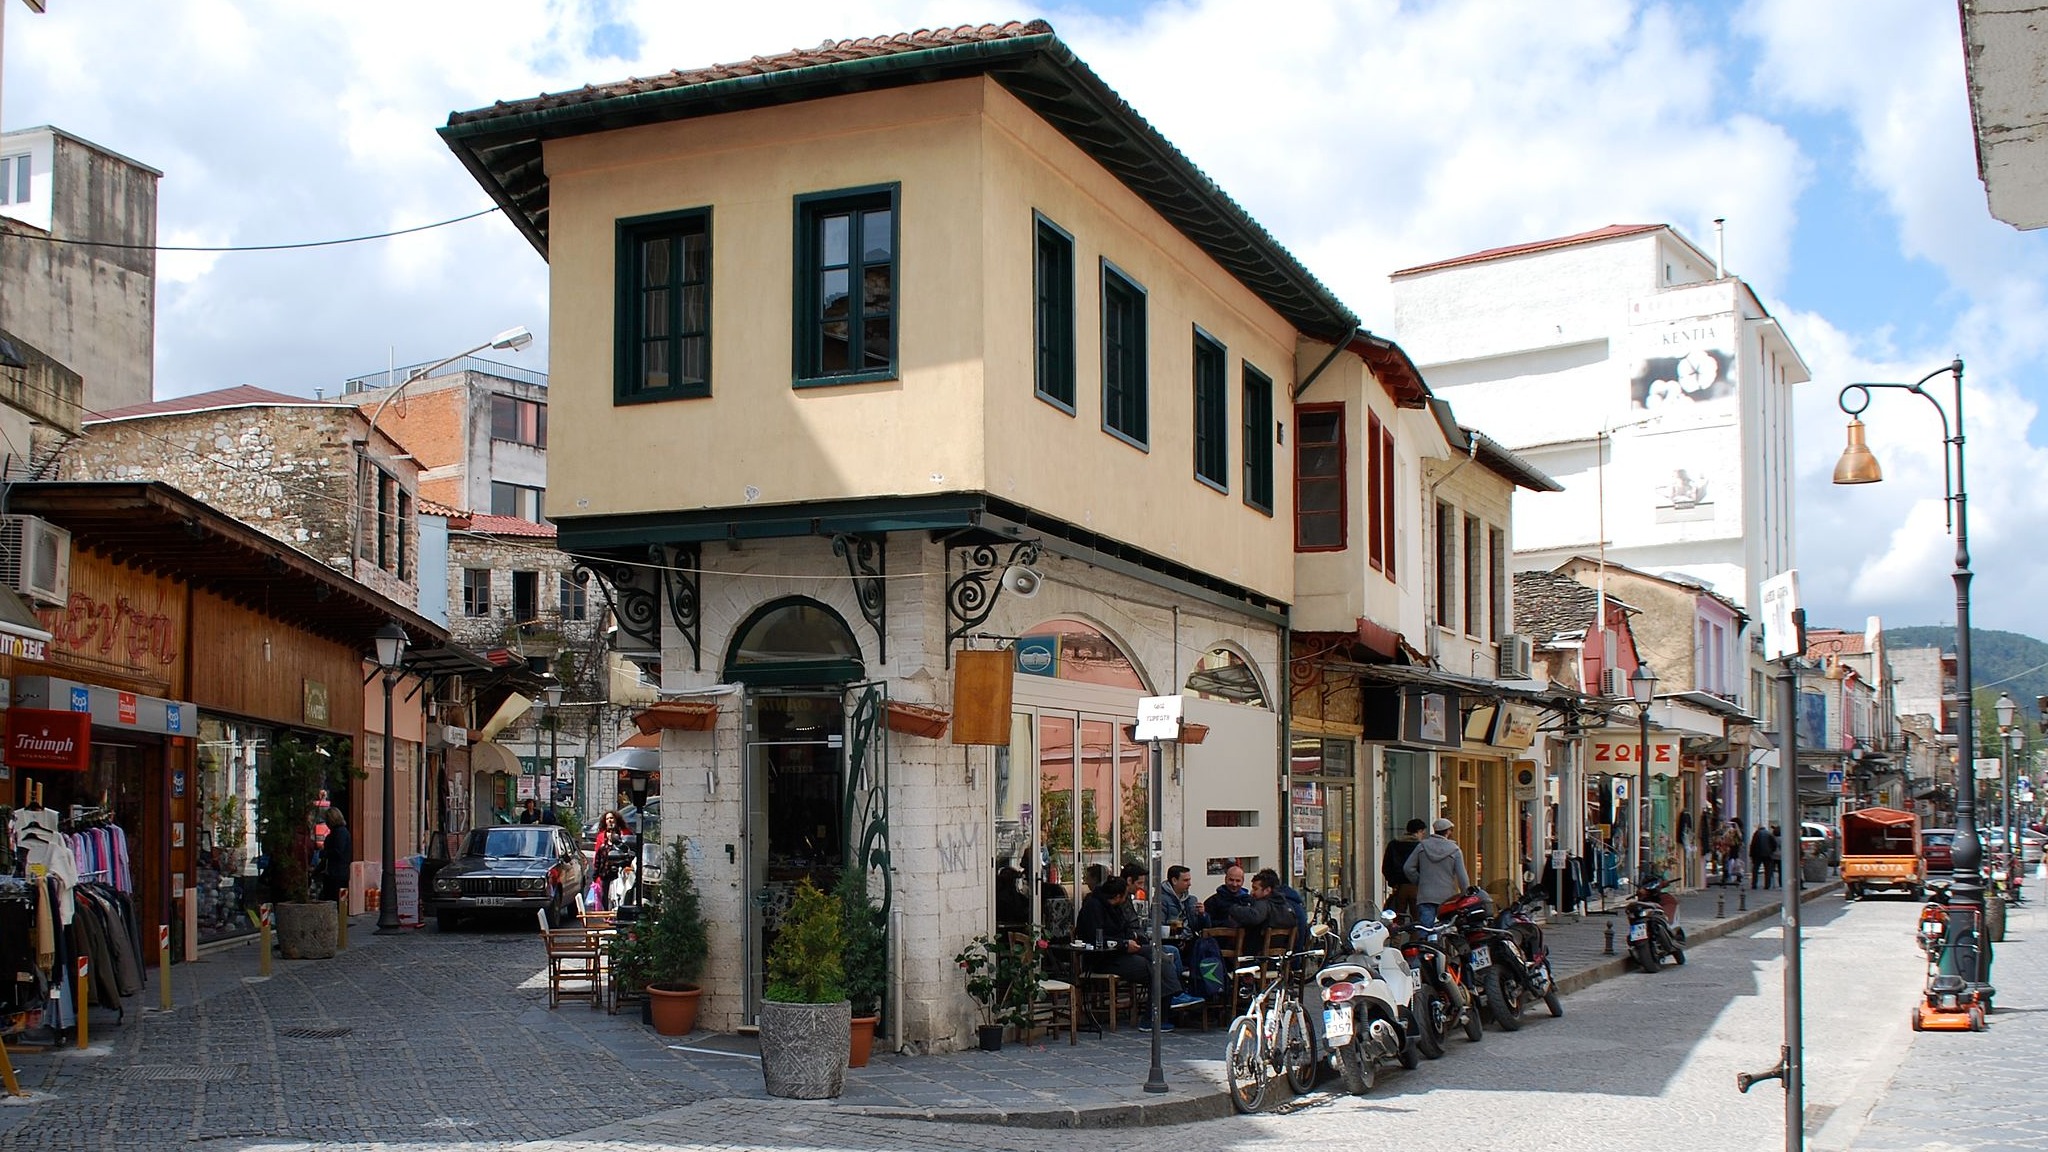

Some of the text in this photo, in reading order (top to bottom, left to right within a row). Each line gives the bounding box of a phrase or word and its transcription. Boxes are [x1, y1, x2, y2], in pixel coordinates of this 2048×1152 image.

[1662, 327, 1716, 345] KENTIA
[0, 633, 45, 661] ΠΤΩΣΕΙΣ
[15, 733, 74, 754] Triumph
[1854, 863, 1904, 872] TOYOTA
[1332, 1022, 1351, 1034] 357
